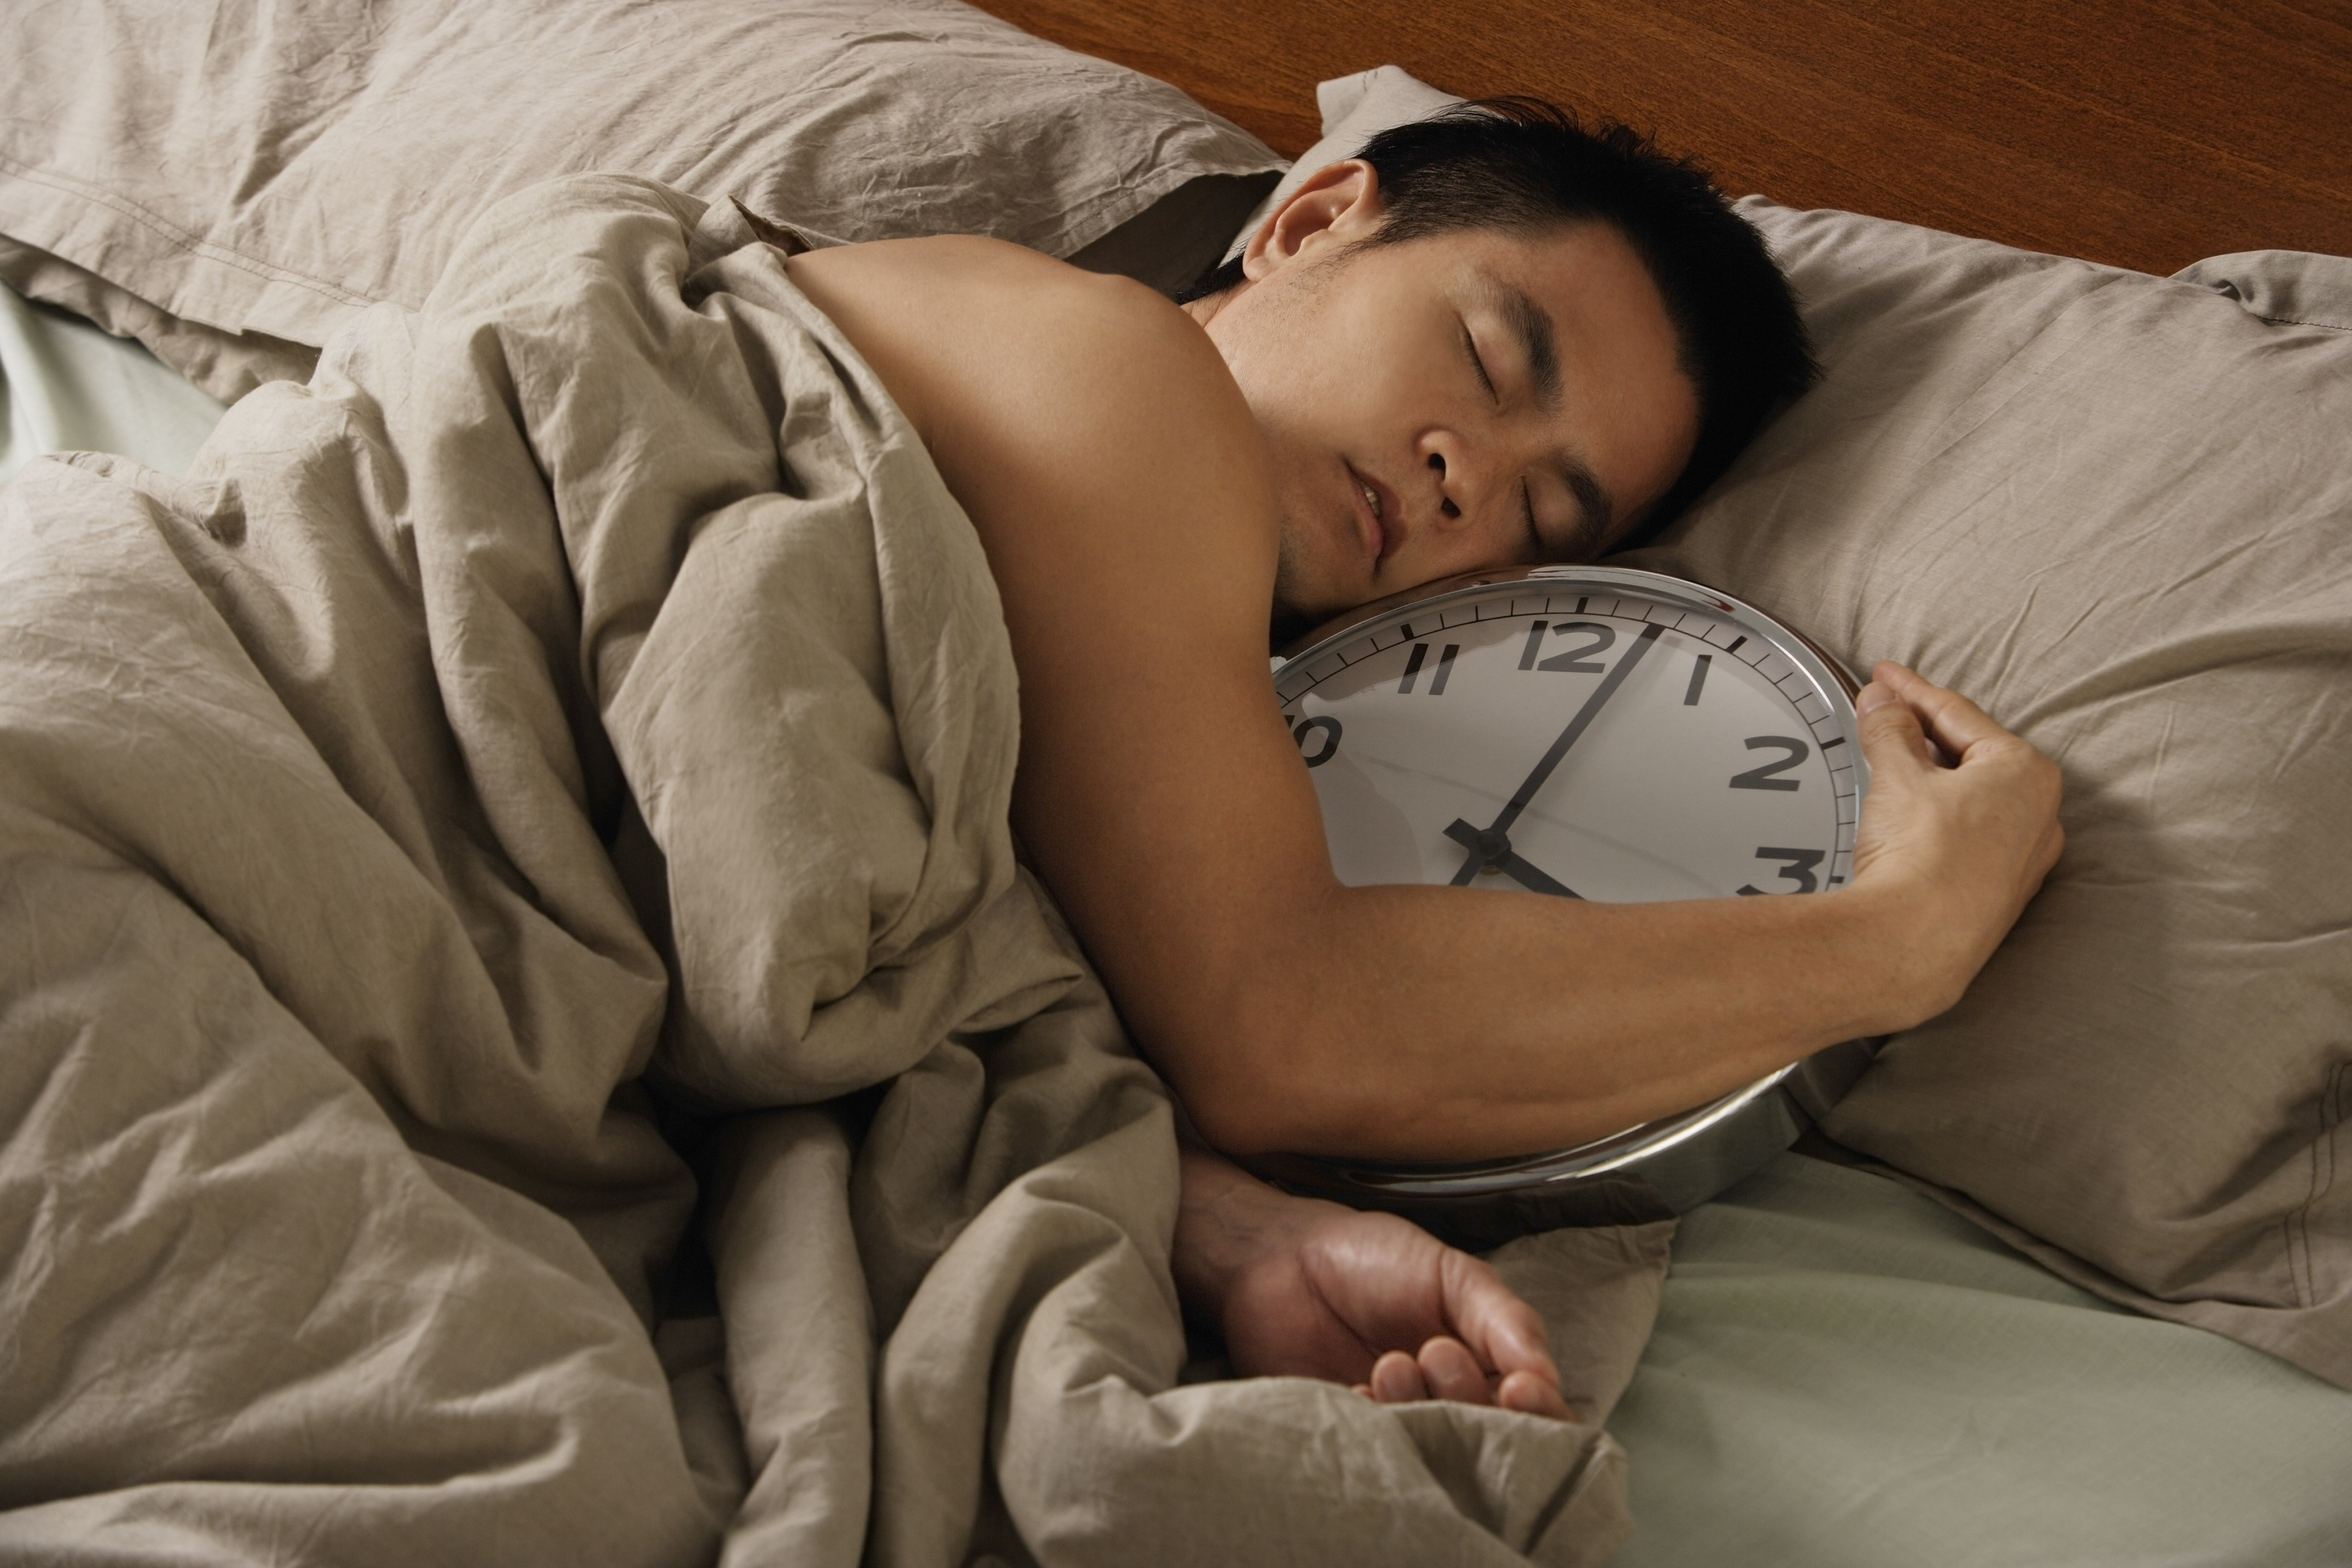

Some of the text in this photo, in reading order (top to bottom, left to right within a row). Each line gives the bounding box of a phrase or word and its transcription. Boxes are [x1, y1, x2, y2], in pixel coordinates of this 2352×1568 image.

[1397, 643, 1460, 696] 11
[1517, 620, 1616, 673] 12
[1683, 654, 1713, 706] 1
[1284, 714, 1343, 768] 0
[1729, 735, 1809, 792] 2
[1735, 846, 1826, 896] 3
